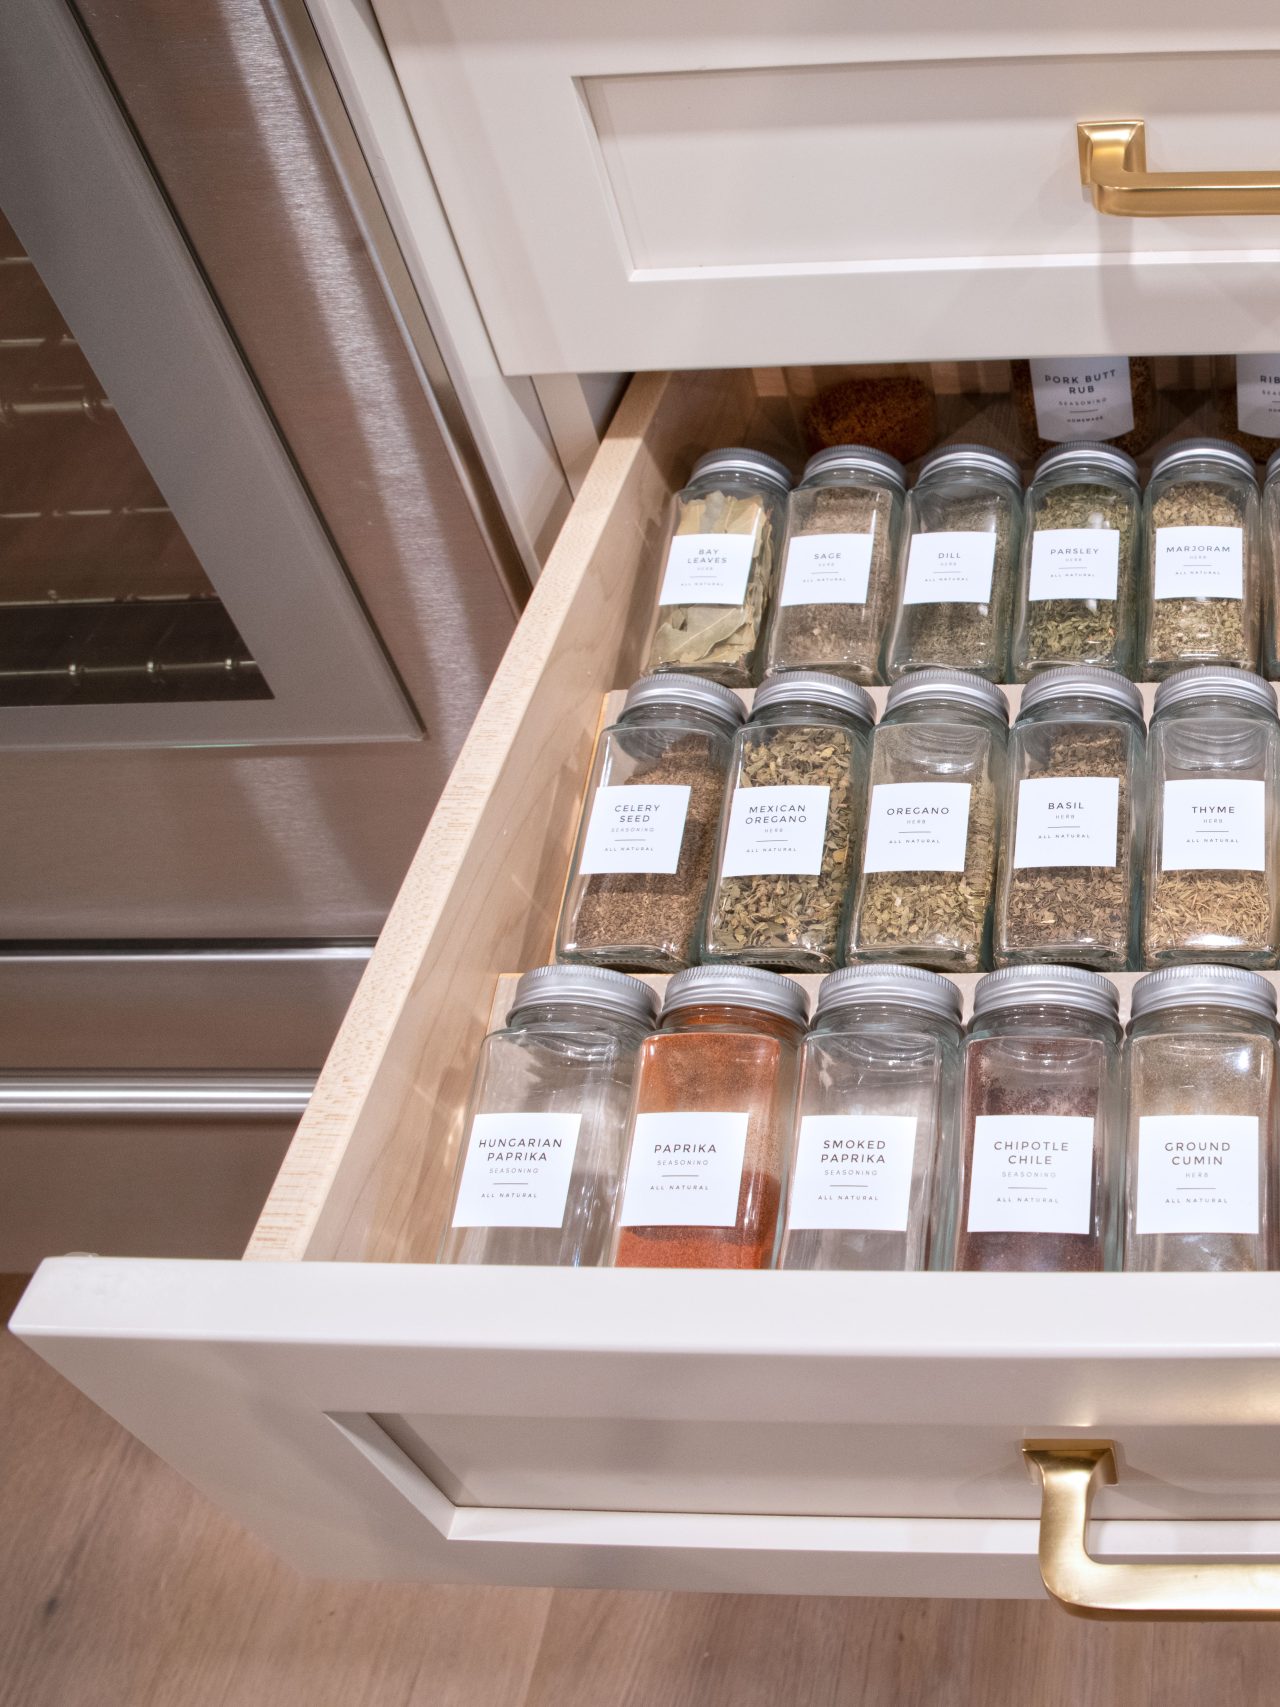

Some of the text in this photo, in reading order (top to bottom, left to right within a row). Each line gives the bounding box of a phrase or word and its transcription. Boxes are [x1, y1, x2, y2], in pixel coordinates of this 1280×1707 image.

[1044, 369, 1116, 384] PORK BUTT
[1260, 375, 1280, 384] RIB
[1069, 385, 1094, 394] RUB
[1166, 545, 1230, 553] MARJORAM
[814, 552, 841, 560] SAGE
[614, 804, 660, 812] CELERY
[749, 804, 806, 814] MEXICAN
[1048, 802, 1084, 810] BASIL
[1192, 806, 1234, 814] THYME
[886, 807, 950, 816] OREGANO
[620, 814, 650, 823] SEED
[745, 815, 807, 825] OREGANO
[478, 1138, 562, 1148] HUNGARIAN
[823, 1140, 886, 1150] SMOKED
[994, 1141, 1068, 1152] CHIPOTLE
[1164, 1141, 1230, 1152] GROUND
[654, 1144, 716, 1153] PAPRIKA
[487, 1152, 547, 1161] PAPRIKA
[821, 1153, 885, 1164] PAPRIKA
[1008, 1154, 1052, 1165] CHILE
[1171, 1156, 1222, 1166] CUMIN
[1001, 1170, 1056, 1178] SEASONING
